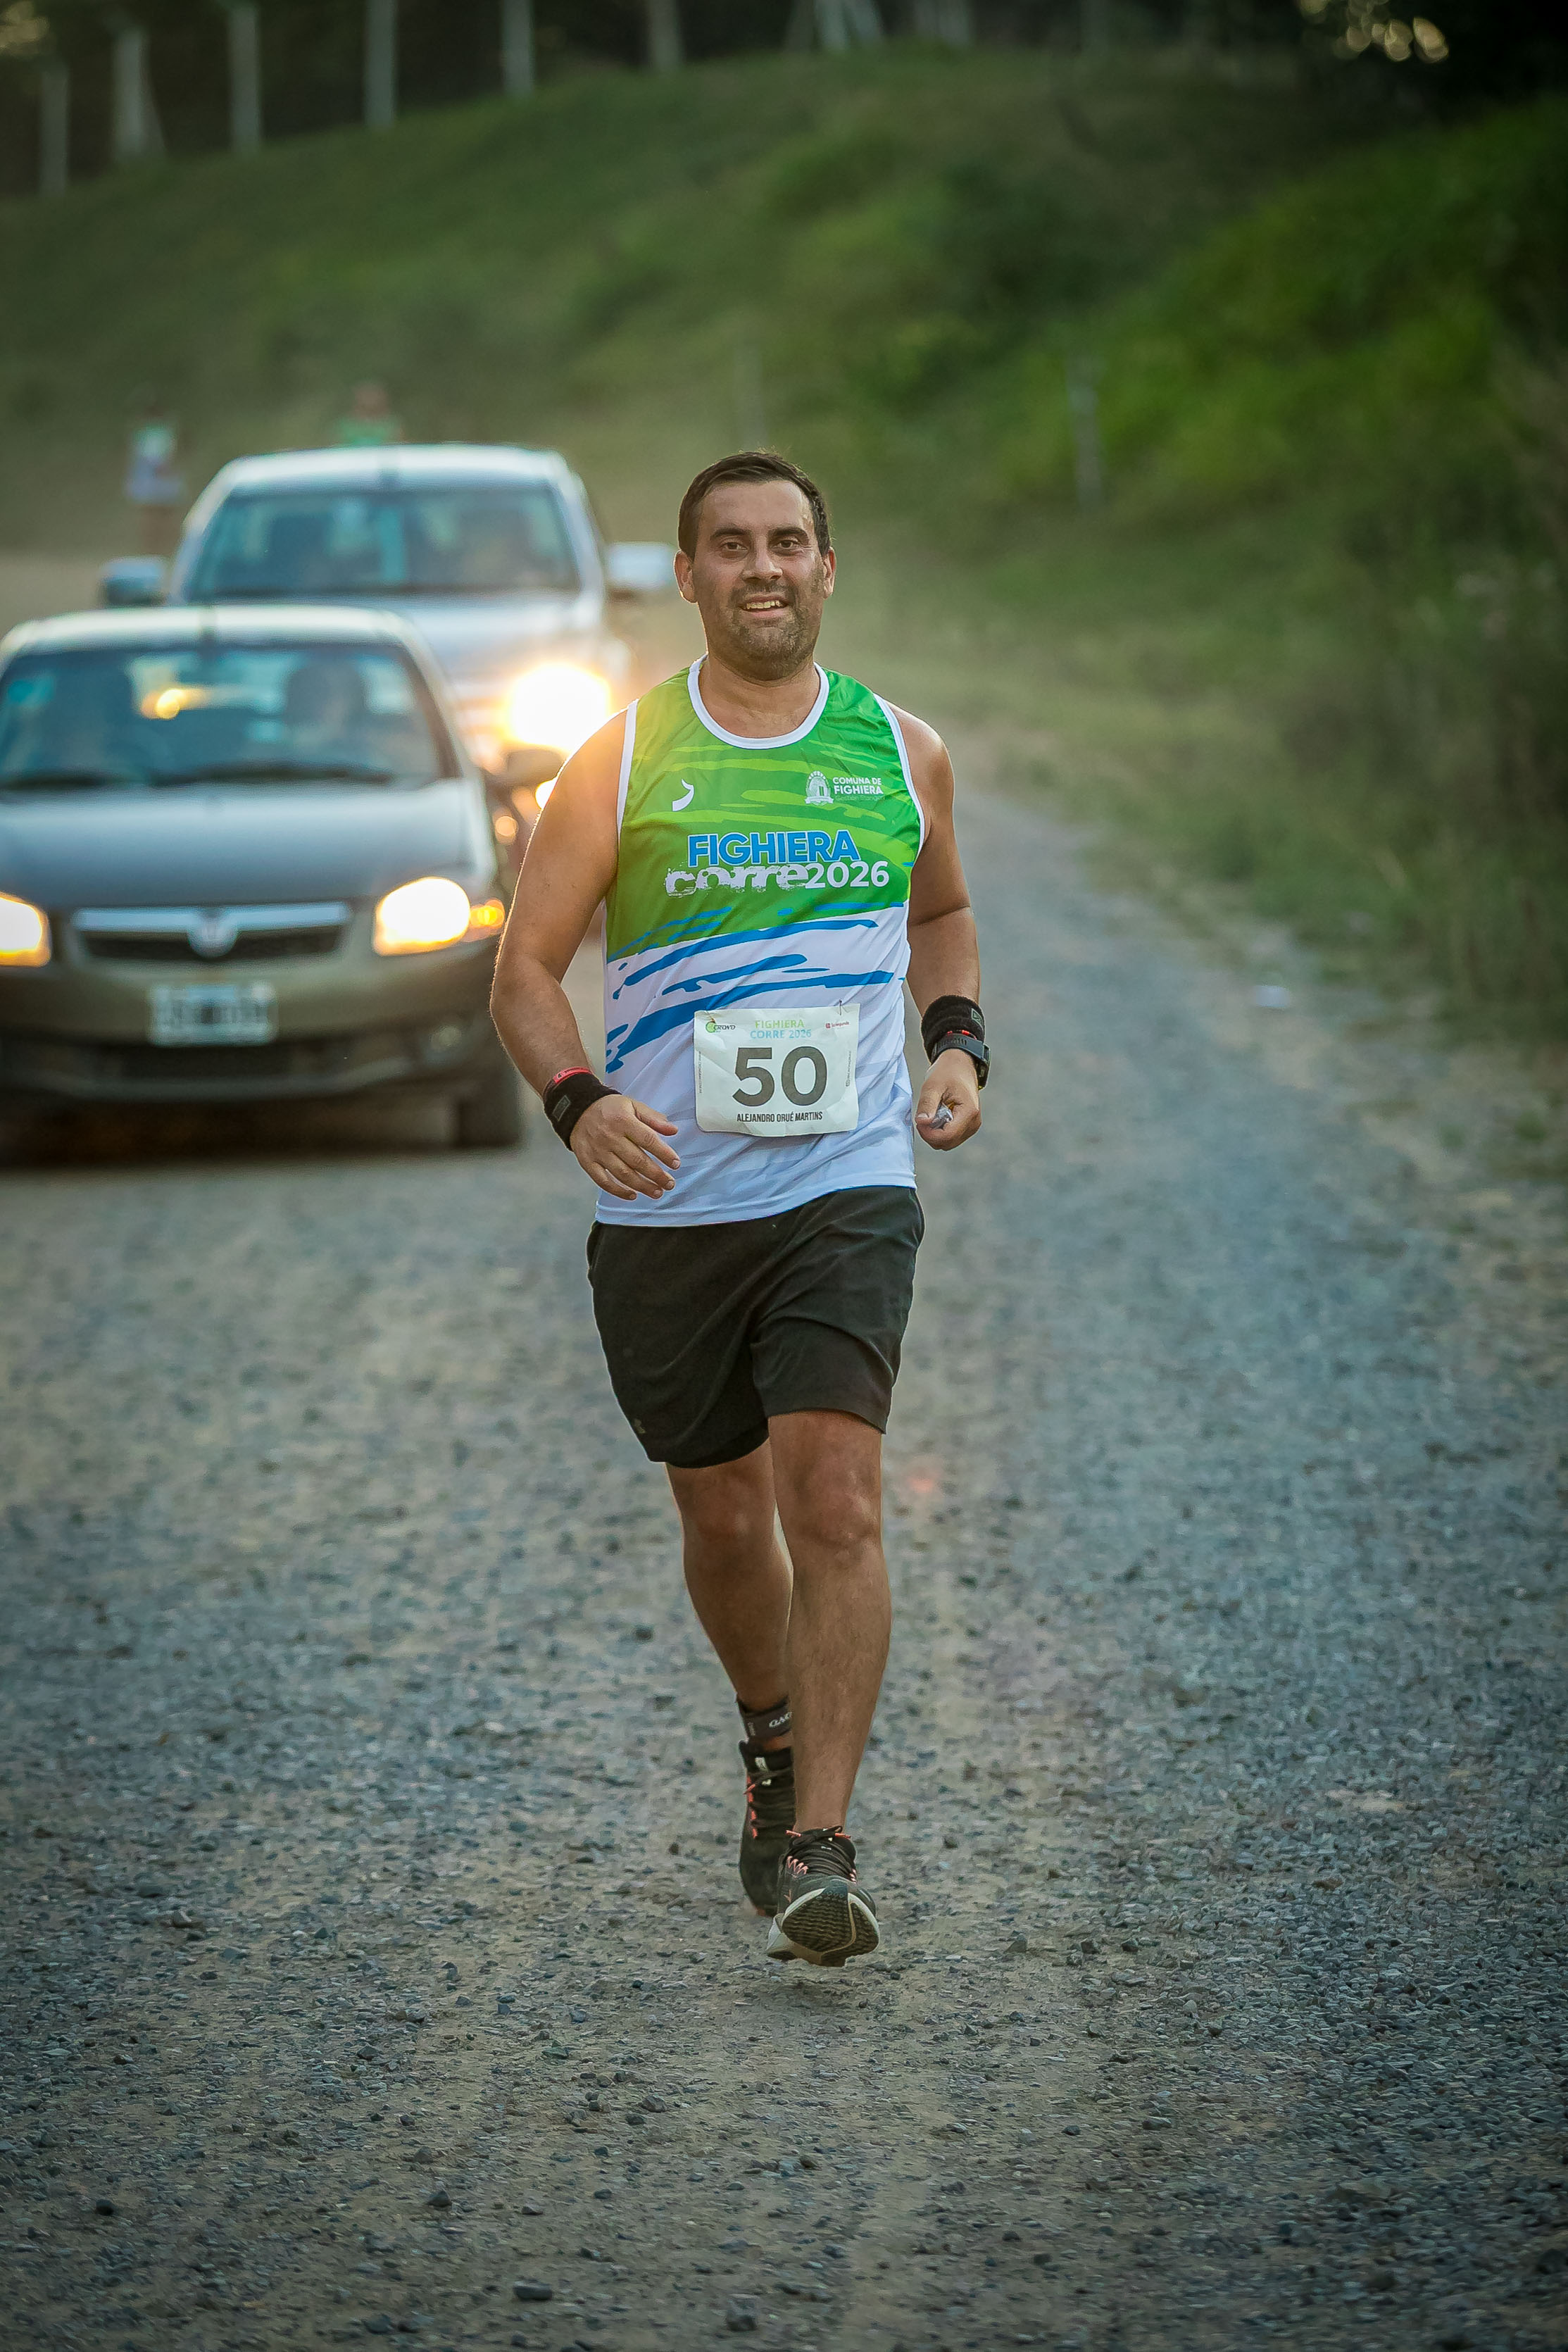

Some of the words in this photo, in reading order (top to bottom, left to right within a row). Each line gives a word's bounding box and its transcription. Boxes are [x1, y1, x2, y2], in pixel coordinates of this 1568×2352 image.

[832, 777, 870, 785] COMUNA
[872, 777, 882, 786] DE
[833, 785, 884, 795] FIGHIERA
[688, 830, 861, 868] FIGHIERA
[755, 1019, 805, 1028] FIGHIERA
[750, 1030, 784, 1039] CORRE
[789, 1029, 812, 1039] 2026
[732, 1046, 827, 1107] 50
[736, 1113, 774, 1122] ALEJANDRO
[776, 1111, 794, 1122] ORUÉ
[795, 1111, 823, 1121] MARTINS
